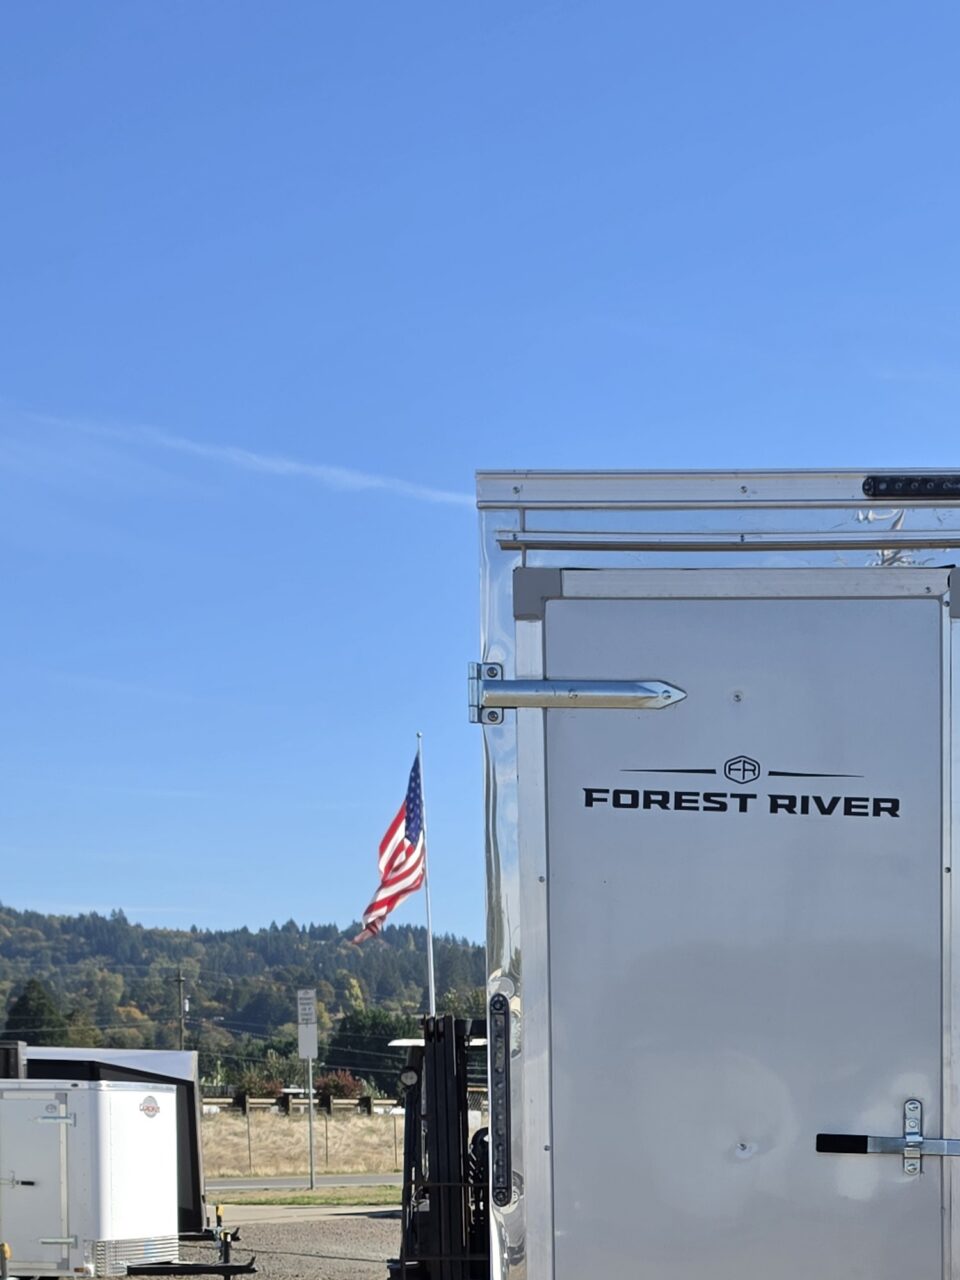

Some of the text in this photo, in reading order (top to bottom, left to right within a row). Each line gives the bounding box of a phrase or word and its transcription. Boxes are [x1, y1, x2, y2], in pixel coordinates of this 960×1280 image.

[728, 759, 757, 781] FR
[582, 787, 901, 818] FOREST RIVER
